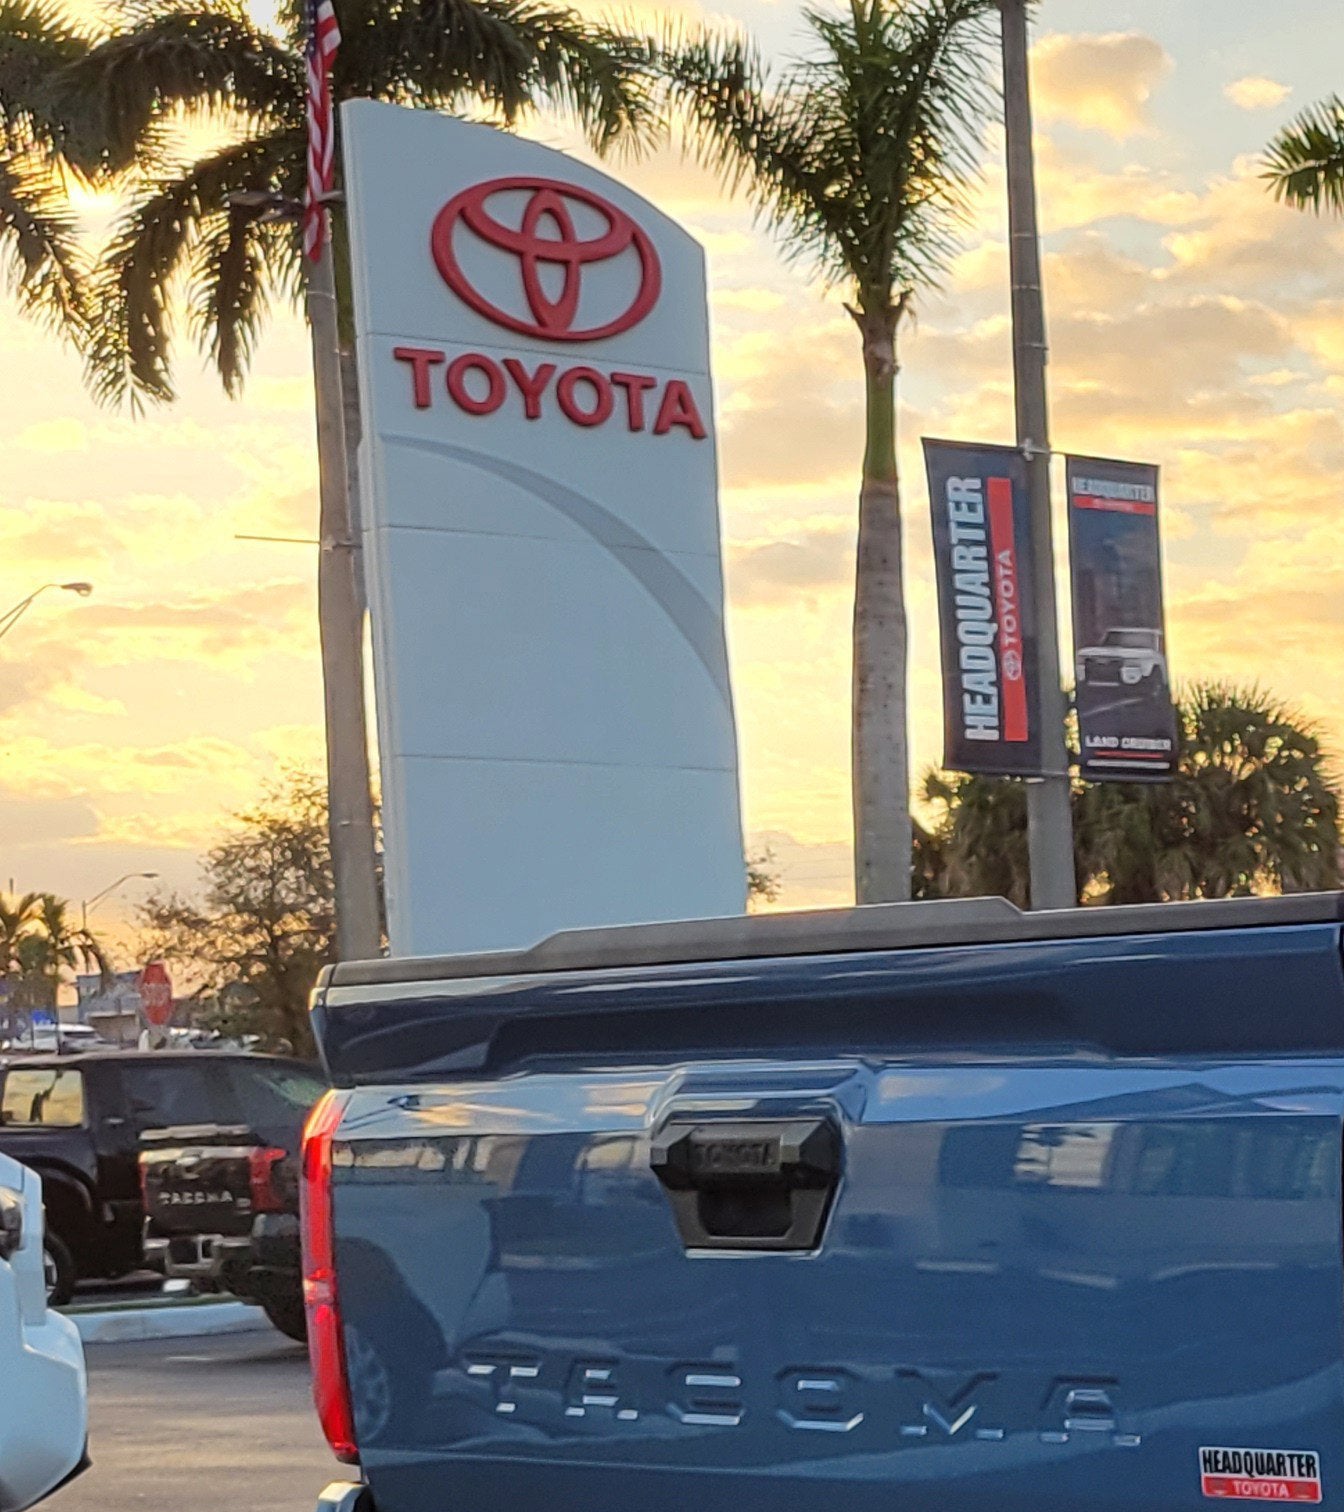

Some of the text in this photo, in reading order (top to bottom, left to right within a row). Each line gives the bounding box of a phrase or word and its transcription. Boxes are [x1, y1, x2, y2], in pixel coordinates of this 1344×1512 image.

[393, 346, 708, 440] TOYOTA
[945, 475, 999, 741] HEADQUARTER
[998, 549, 1020, 647] TOYOTA
[463, 1353, 1142, 1446] TACOMA
[1202, 1449, 1317, 1478] HEADQUARTER
[1232, 1480, 1290, 1498] TOYOTA
